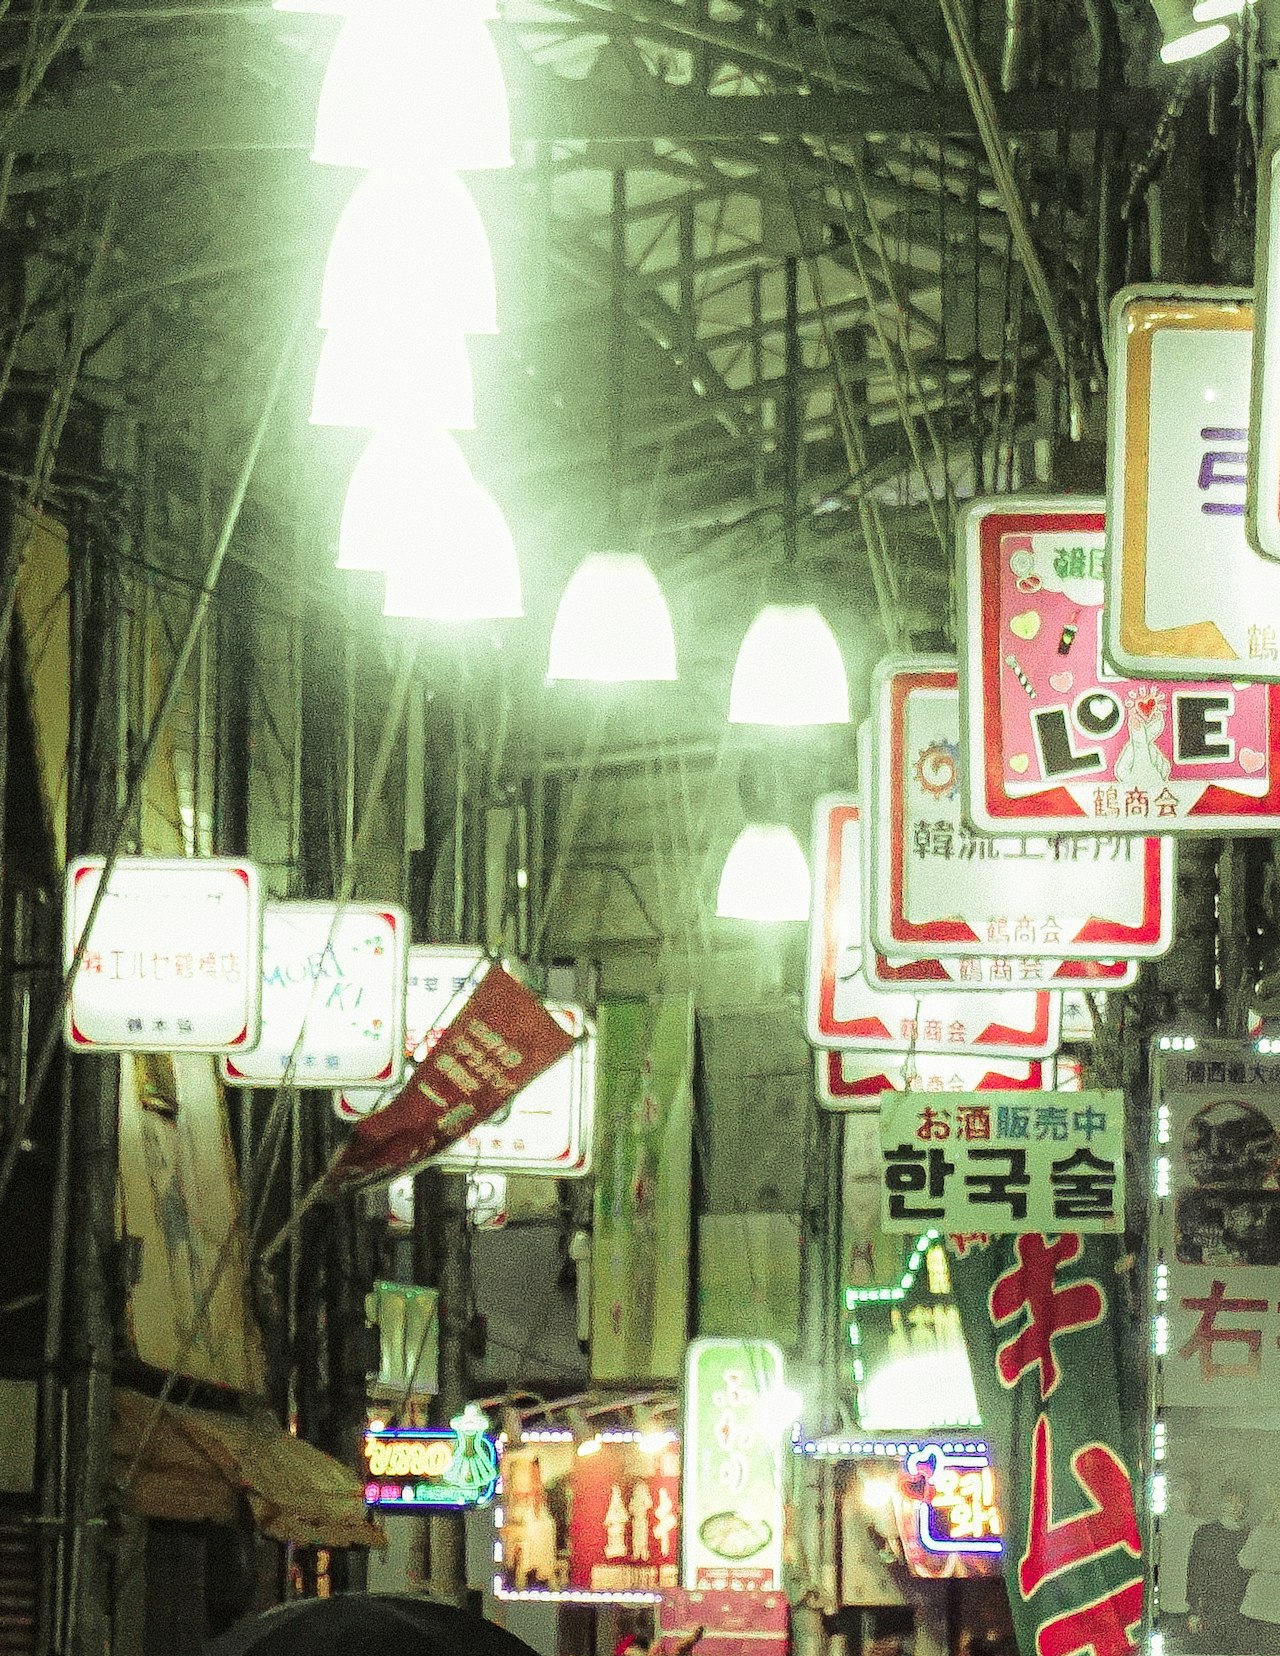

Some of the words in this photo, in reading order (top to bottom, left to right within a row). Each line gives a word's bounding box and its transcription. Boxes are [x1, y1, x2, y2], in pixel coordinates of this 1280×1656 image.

[1032, 690, 1234, 779] LOE
[1093, 786, 1180, 819] 鶴商会
[987, 916, 1063, 944] 鶴商会
[916, 1105, 1107, 1142] お酒販売中
[882, 1144, 1118, 1220] 한국술
